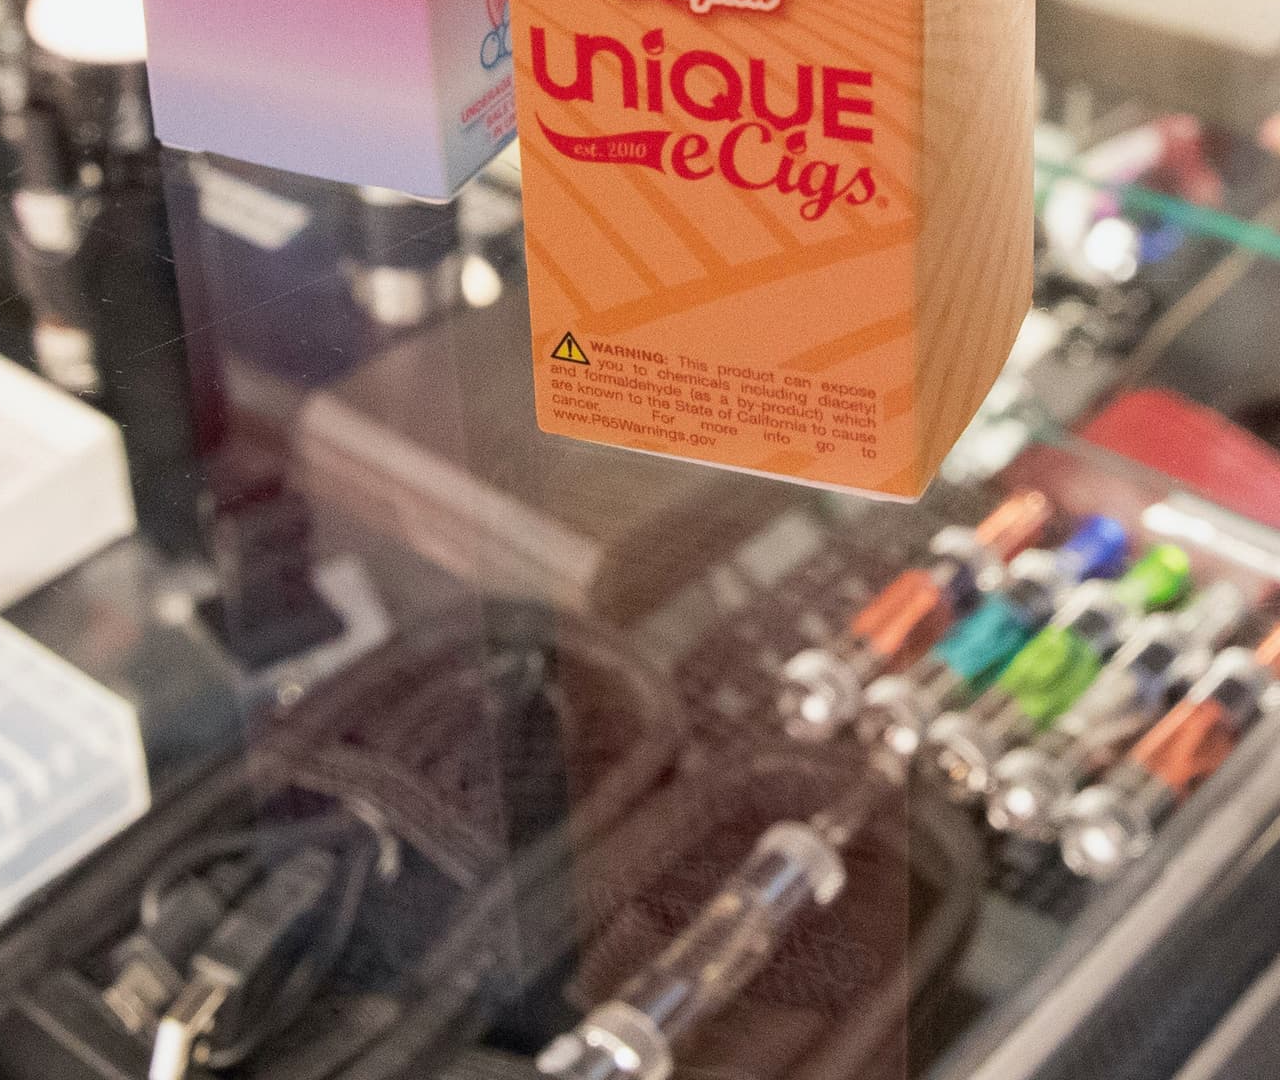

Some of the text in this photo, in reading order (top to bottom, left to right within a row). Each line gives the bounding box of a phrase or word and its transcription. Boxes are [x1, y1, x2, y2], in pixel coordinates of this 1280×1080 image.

[607, 143, 647, 159] 2010
[671, 122, 877, 221] eCigs
[549, 363, 576, 377] and
[584, 369, 682, 397] formaldehyde
[690, 388, 711, 402] (as
[833, 413, 876, 429] which
[590, 340, 876, 399] WARNING: This product can expose
[598, 360, 876, 416] you to chemicals including diacetyl
[551, 380, 876, 444] are known to the State of California to cause
[552, 394, 876, 459] cancer. For more info go to
[552, 409, 717, 446] www.P65Warnings.gov
